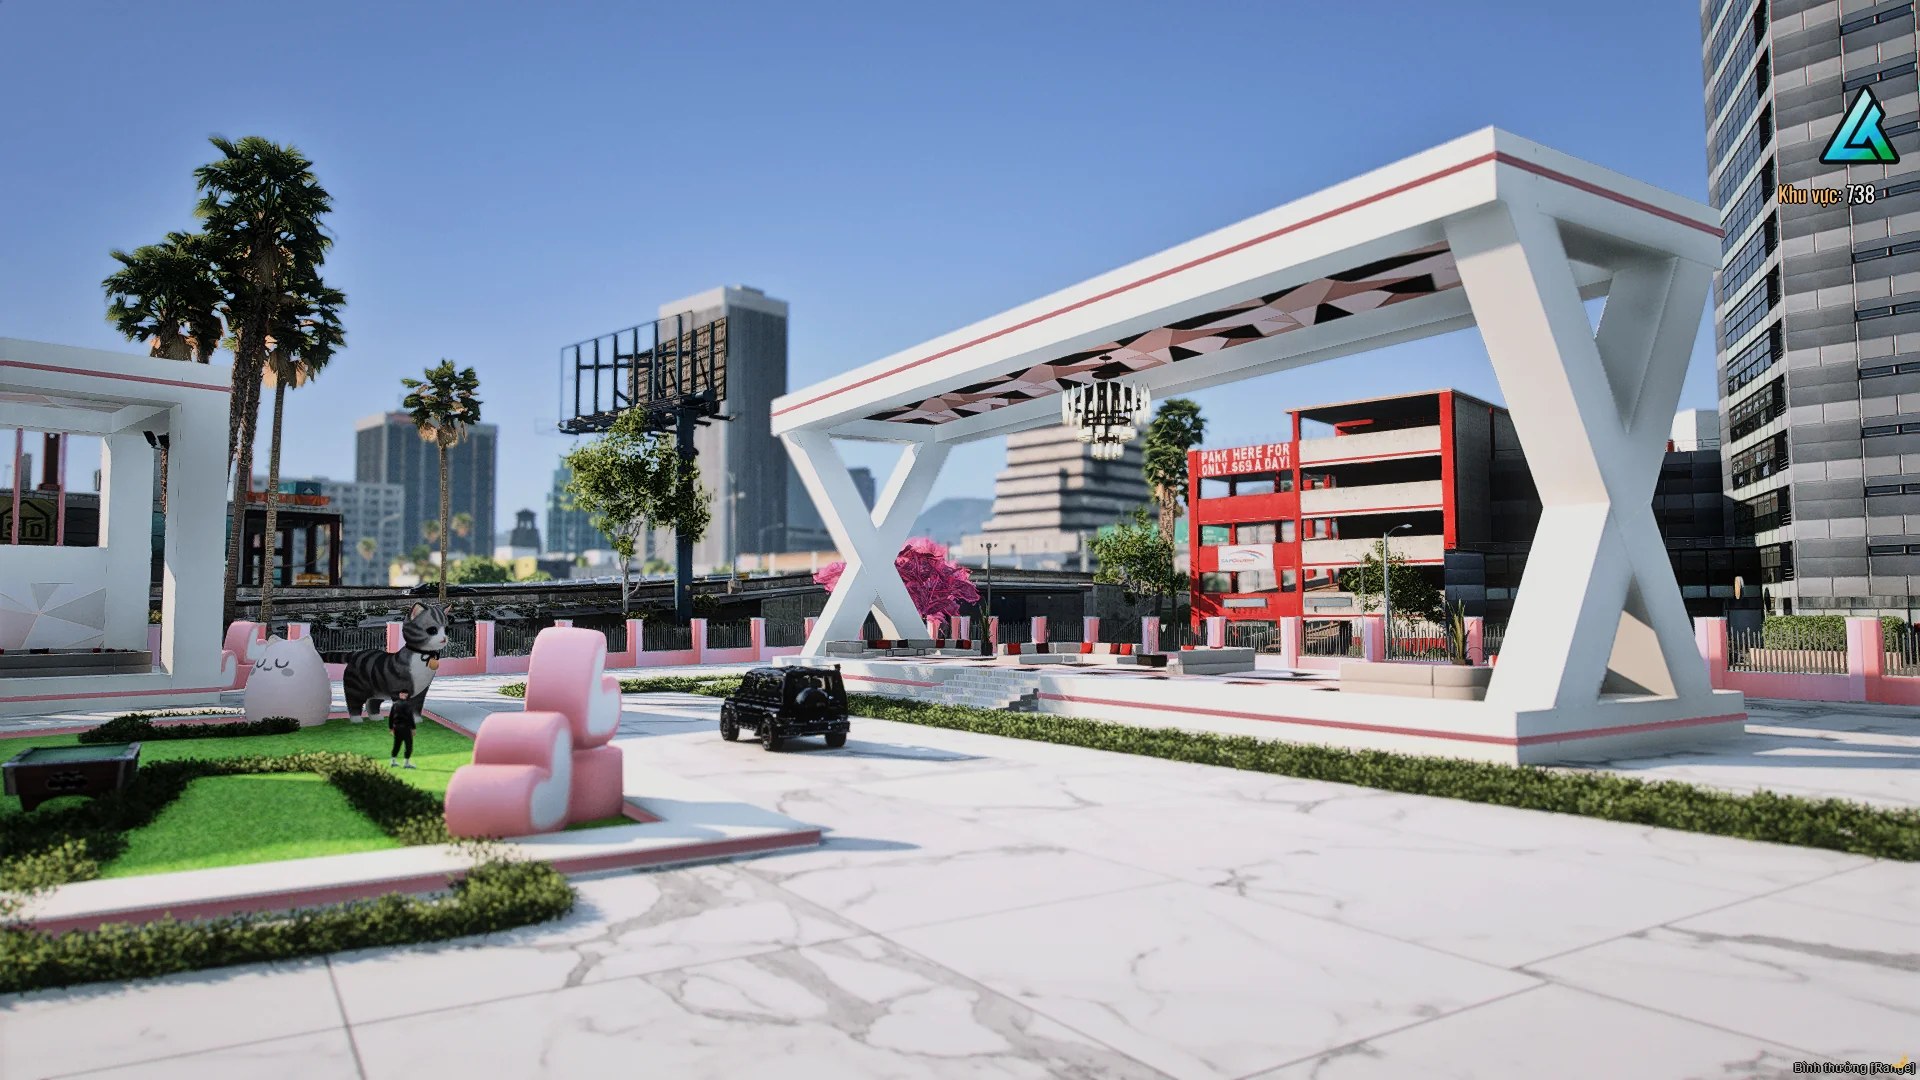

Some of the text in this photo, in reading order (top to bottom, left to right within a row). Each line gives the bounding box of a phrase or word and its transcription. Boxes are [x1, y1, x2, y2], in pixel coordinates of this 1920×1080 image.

[1232, 446, 1262, 461] HERE
[1267, 443, 1290, 457] FOR
[1201, 455, 1290, 476] ONLY $69 A DAY!
